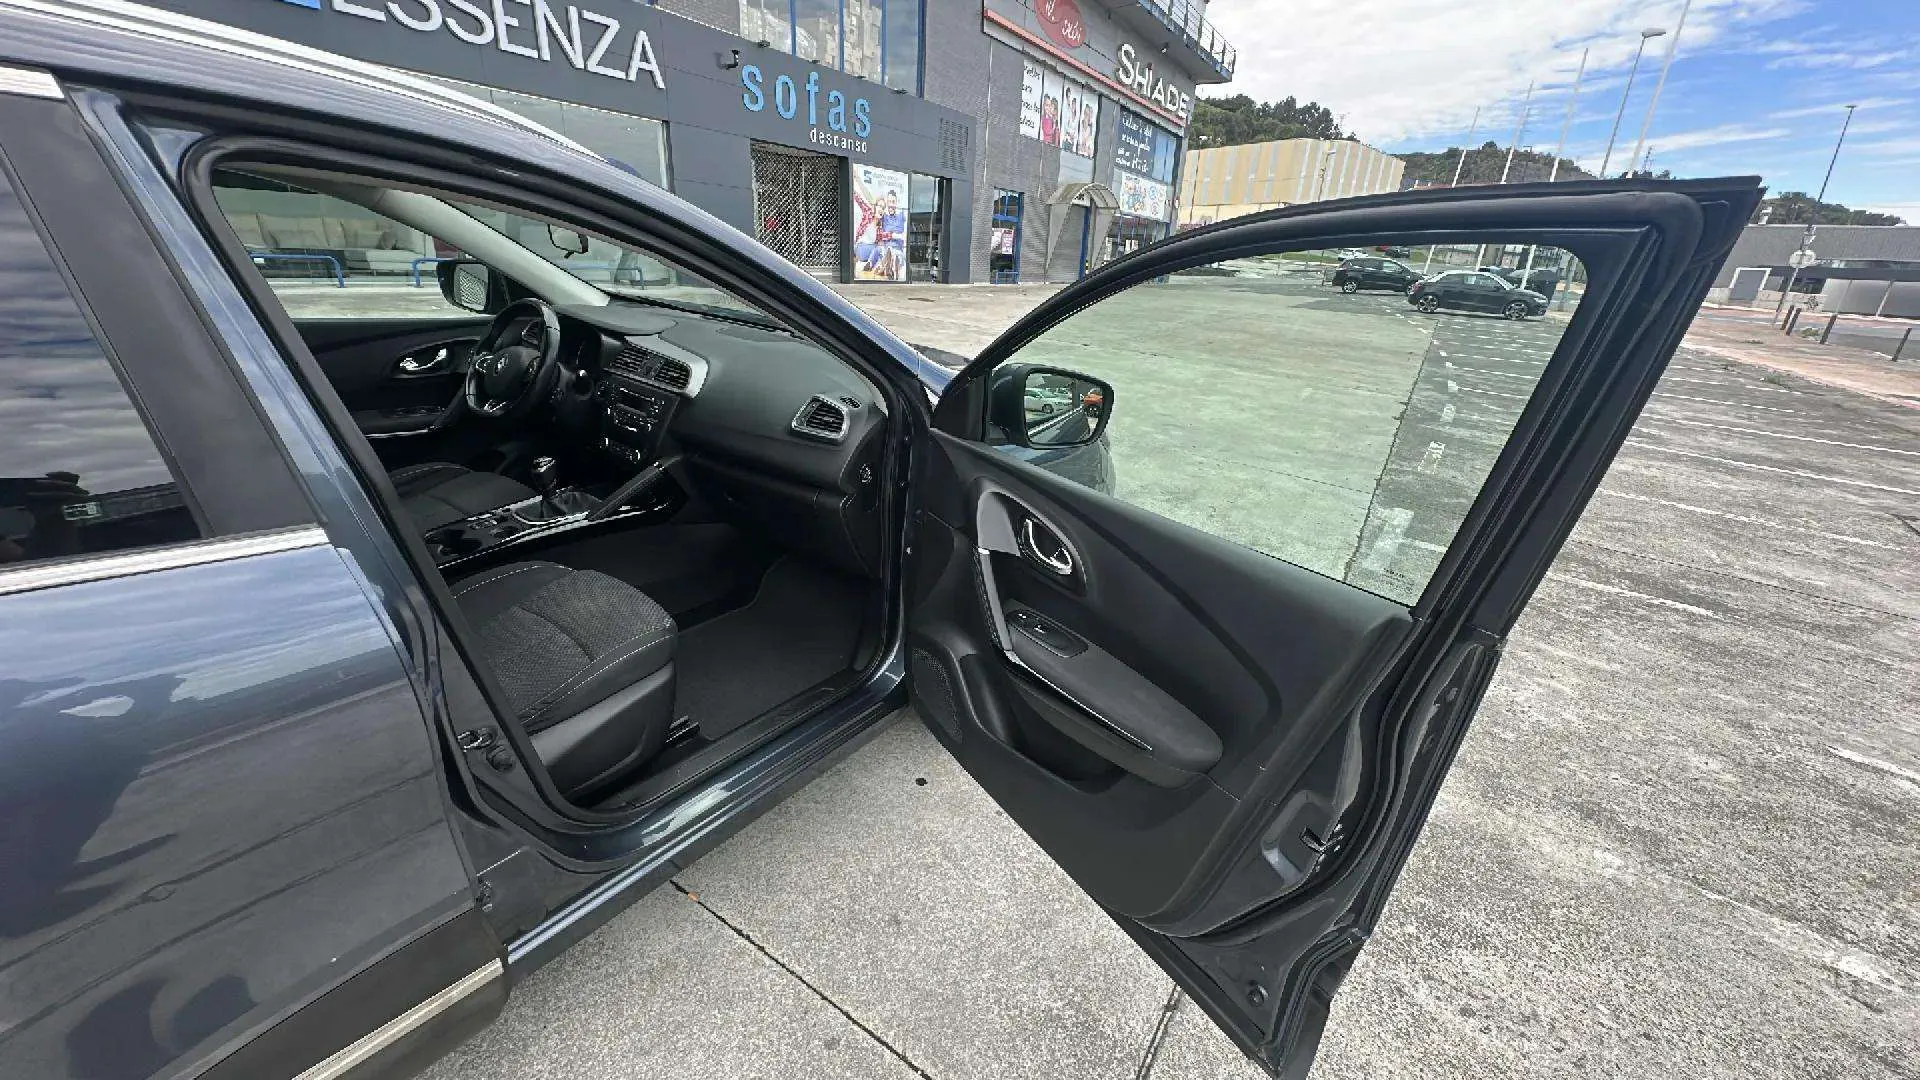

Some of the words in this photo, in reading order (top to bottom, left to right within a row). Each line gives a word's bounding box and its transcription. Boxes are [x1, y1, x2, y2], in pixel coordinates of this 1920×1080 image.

[332, 0, 665, 89] SSENZA
[742, 64, 871, 138] sofas
[810, 128, 868, 153] descanso
